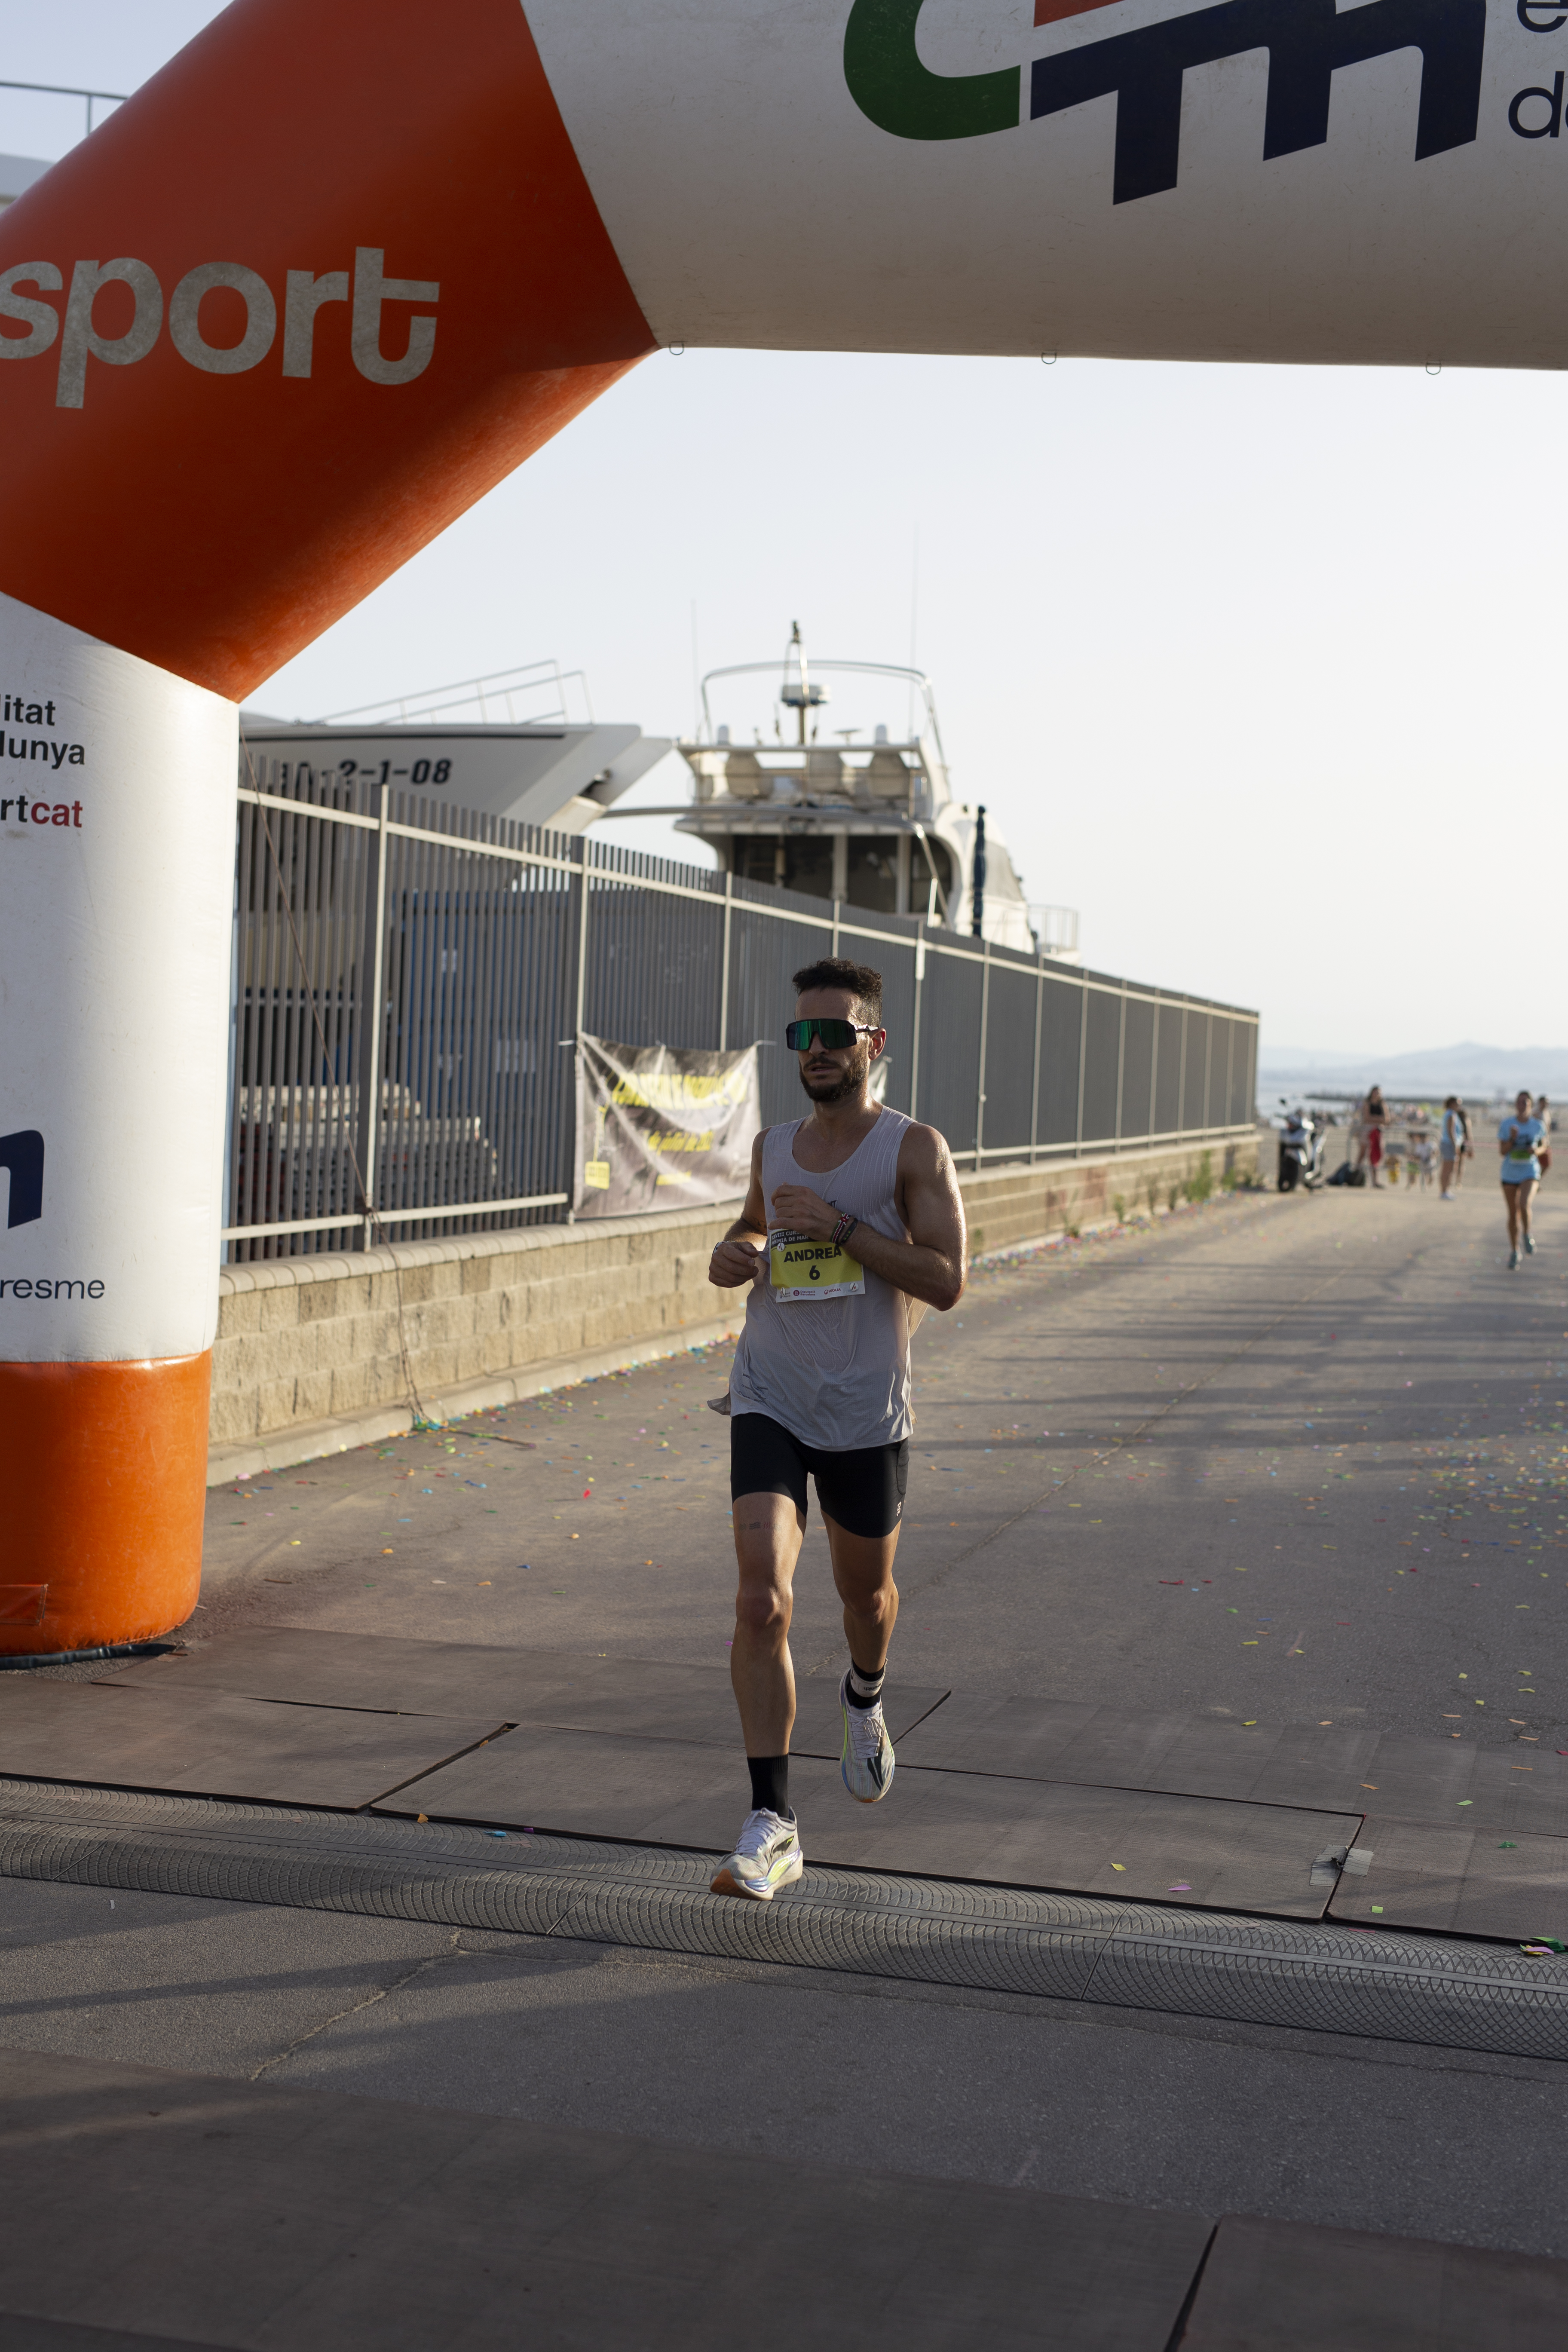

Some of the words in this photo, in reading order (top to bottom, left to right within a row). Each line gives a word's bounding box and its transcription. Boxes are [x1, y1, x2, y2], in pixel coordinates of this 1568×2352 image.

[1508, 71, 1568, 139] d
[0, 246, 440, 409] sport
[0, 694, 56, 726] itat
[0, 795, 83, 828] rtcat
[772, 1236, 787, 1246] PREMIÀ
[784, 1246, 842, 1262] ANDREA
[809, 1265, 820, 1280] 6
[0, 1279, 105, 1299] resme
